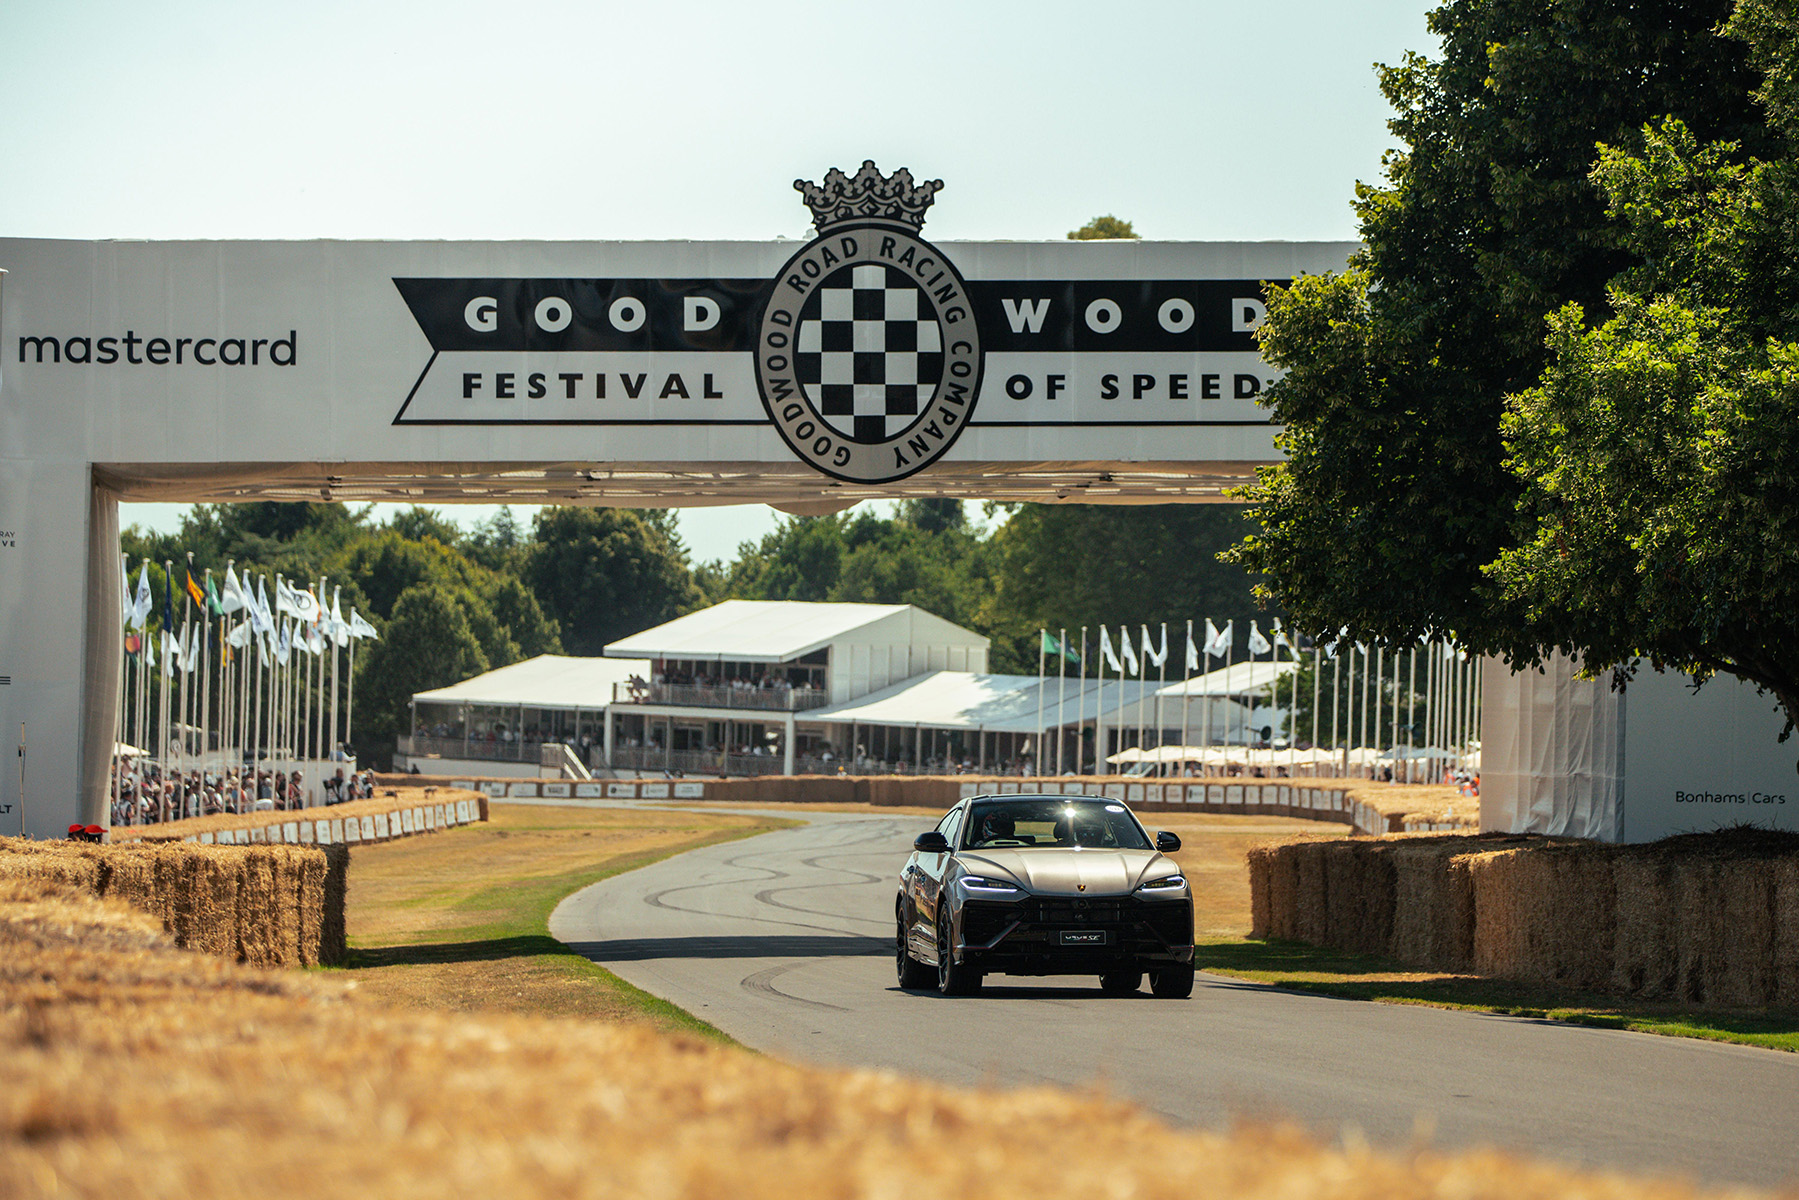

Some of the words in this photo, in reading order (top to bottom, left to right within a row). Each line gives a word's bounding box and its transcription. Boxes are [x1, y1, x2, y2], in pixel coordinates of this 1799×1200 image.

[786, 236, 858, 295] ROAD
[879, 236, 966, 325] RACING
[464, 296, 721, 333] GOOD
[1001, 297, 1266, 334] WOOD
[18, 329, 297, 367] mastercard
[462, 372, 723, 400] FESTIVAL
[1005, 374, 1066, 400] OF
[1100, 373, 1261, 400] SPEED
[767, 309, 851, 467] GOODWOOD
[893, 340, 972, 469] COMPANY
